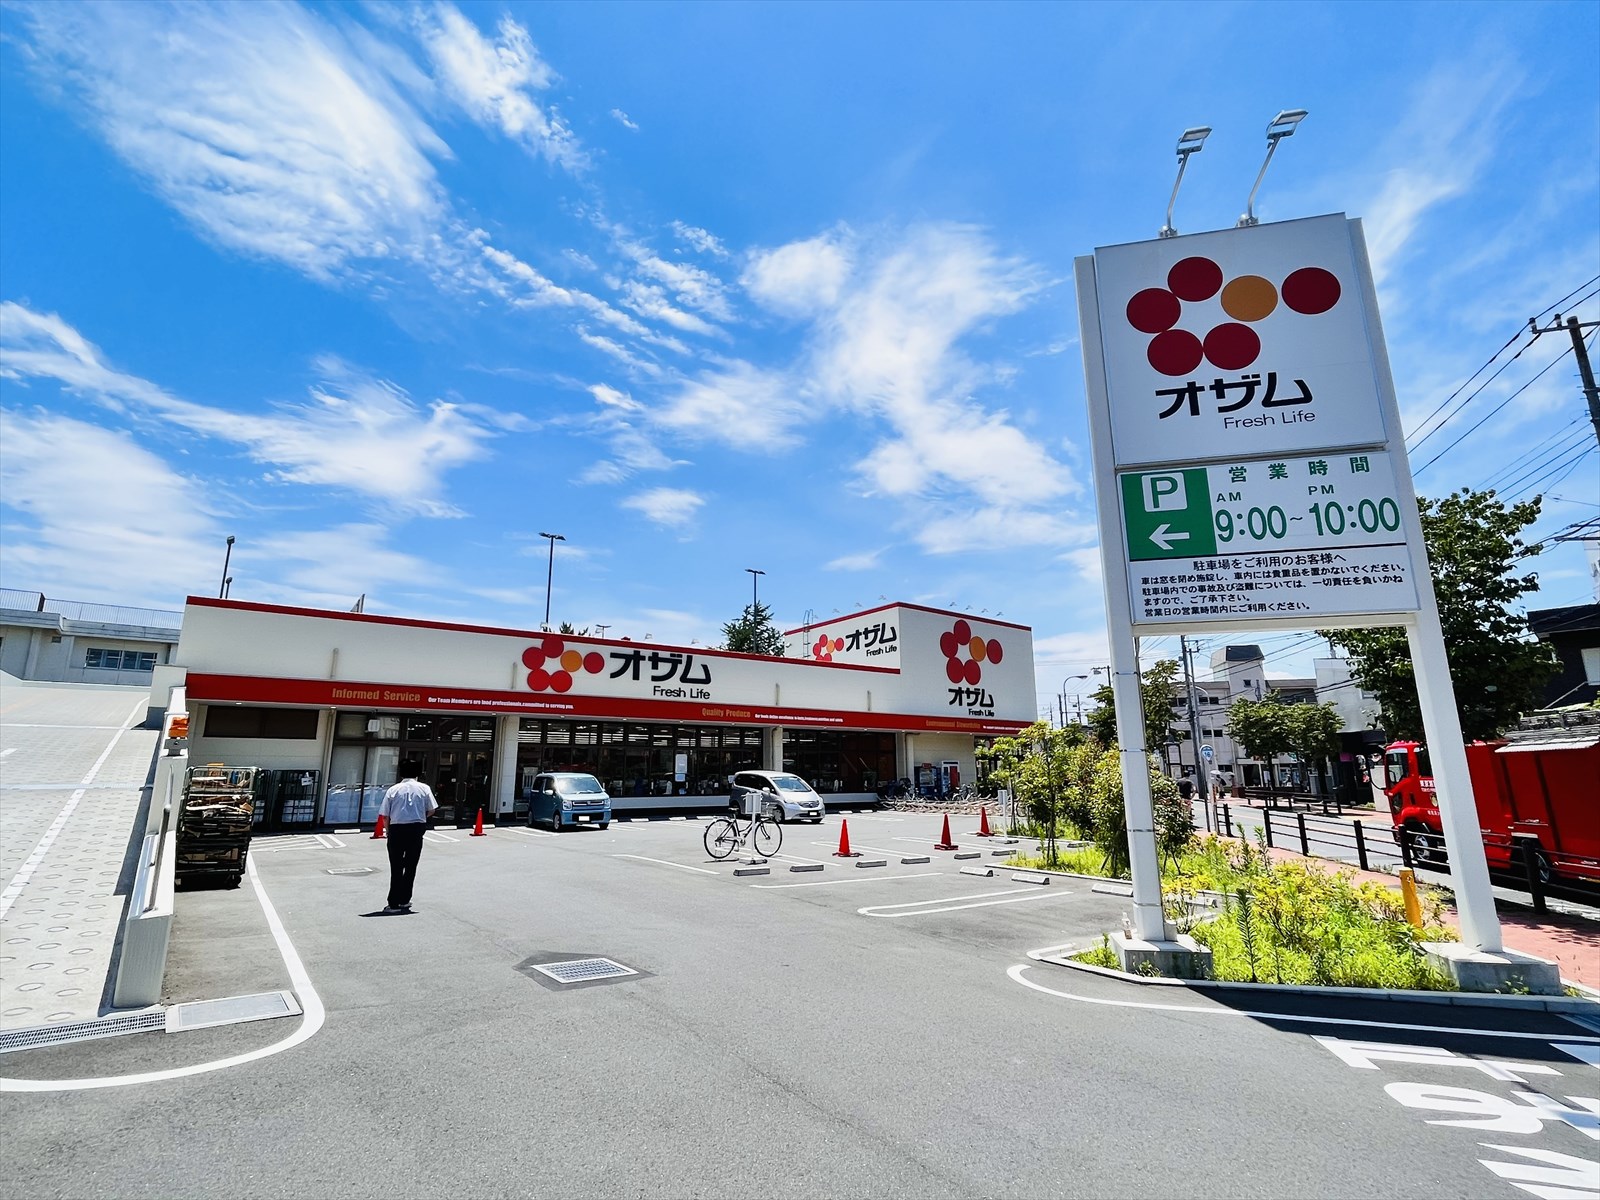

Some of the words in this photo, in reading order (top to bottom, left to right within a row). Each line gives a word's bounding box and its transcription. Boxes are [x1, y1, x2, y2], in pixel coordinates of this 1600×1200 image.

[1155, 371, 1314, 420] オザム
[1224, 412, 1275, 430] Fresh
[1282, 409, 1316, 424] Life
[1228, 456, 1370, 483] 営業時間
[1151, 477, 1178, 508] P
[1216, 492, 1242, 503] AM
[1308, 484, 1335, 496] PM
[1193, 552, 1346, 571] 駐車場をご利用のお客様へ
[843, 622, 897, 652] オザム
[866, 647, 884, 657] Fresh
[885, 644, 897, 654] Life
[610, 650, 712, 684] オザム
[332, 688, 380, 701] Informed
[383, 690, 421, 702] Service
[653, 686, 687, 698] Fresh
[690, 688, 711, 700] Life
[948, 687, 994, 708] オザム
[702, 708, 724, 718] Quality
[725, 709, 751, 718] Produce
